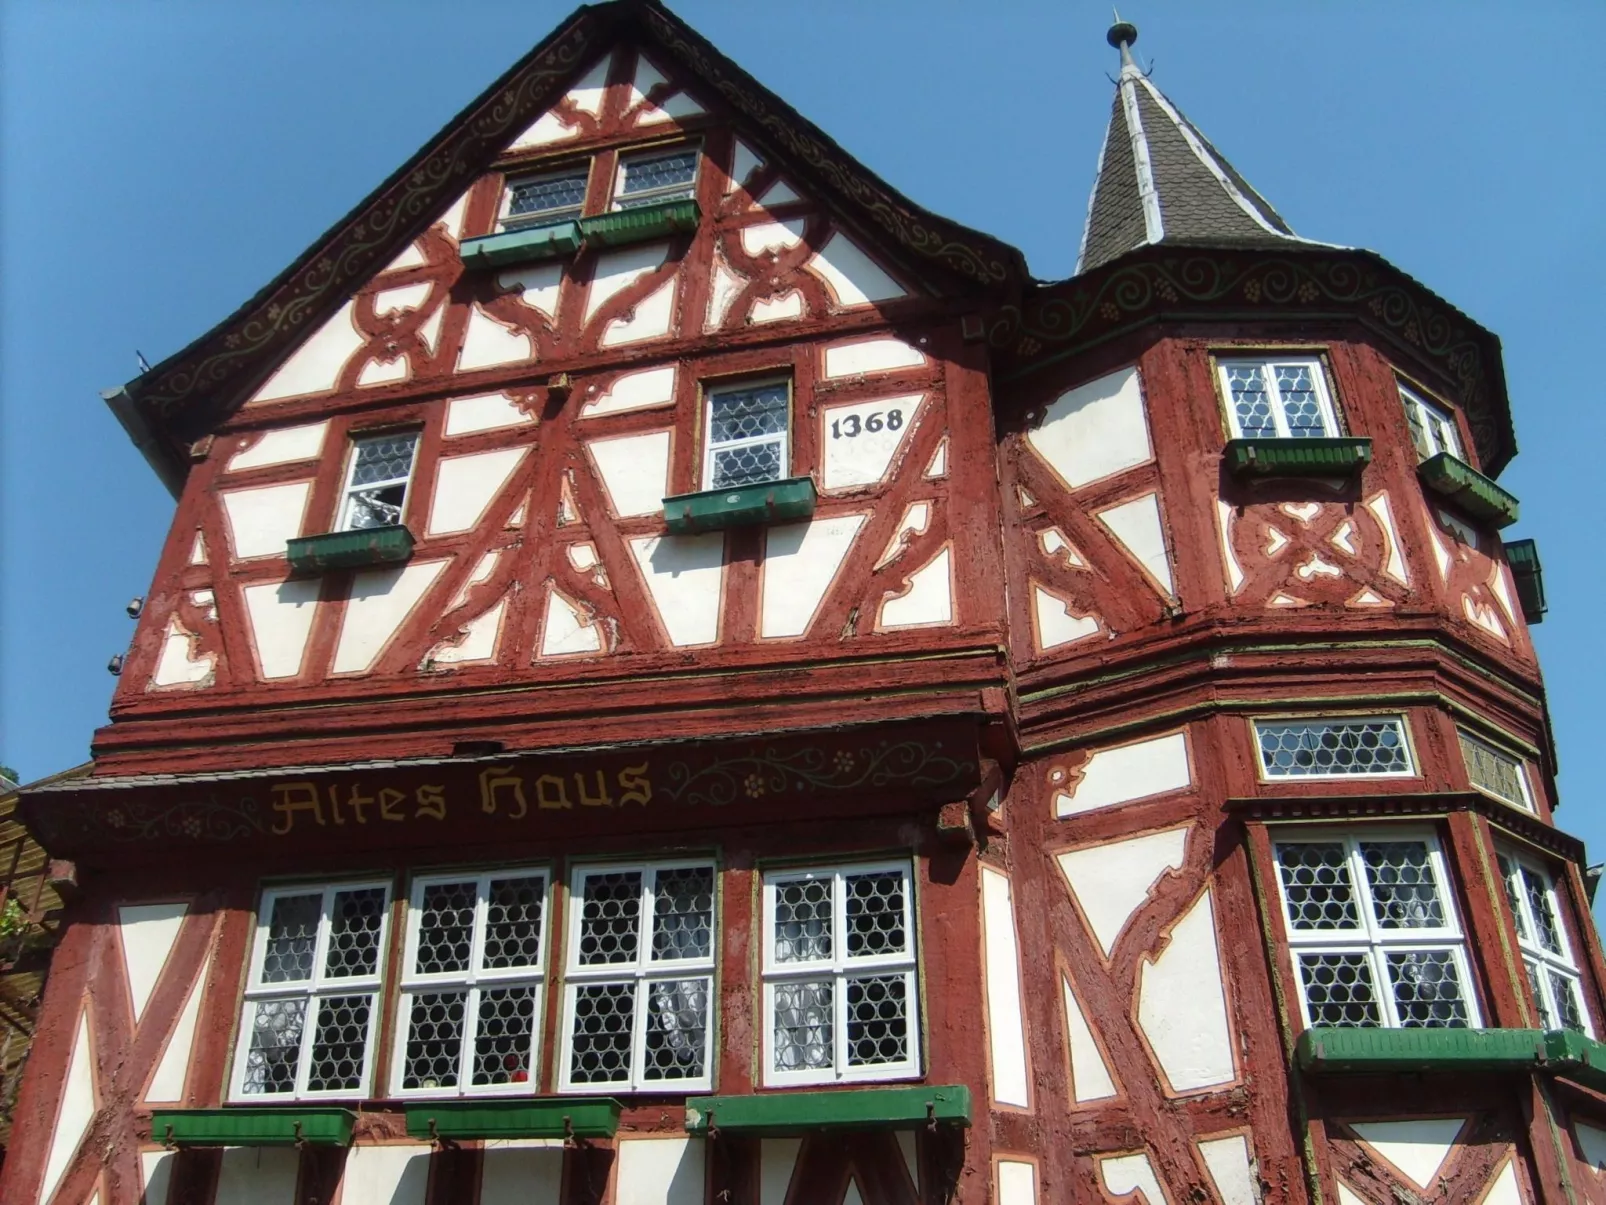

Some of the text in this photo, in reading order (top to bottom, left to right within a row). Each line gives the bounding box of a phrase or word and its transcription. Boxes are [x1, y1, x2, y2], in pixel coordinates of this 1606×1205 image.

[831, 409, 903, 440] 1368
[271, 762, 653, 835] Altes Haus
